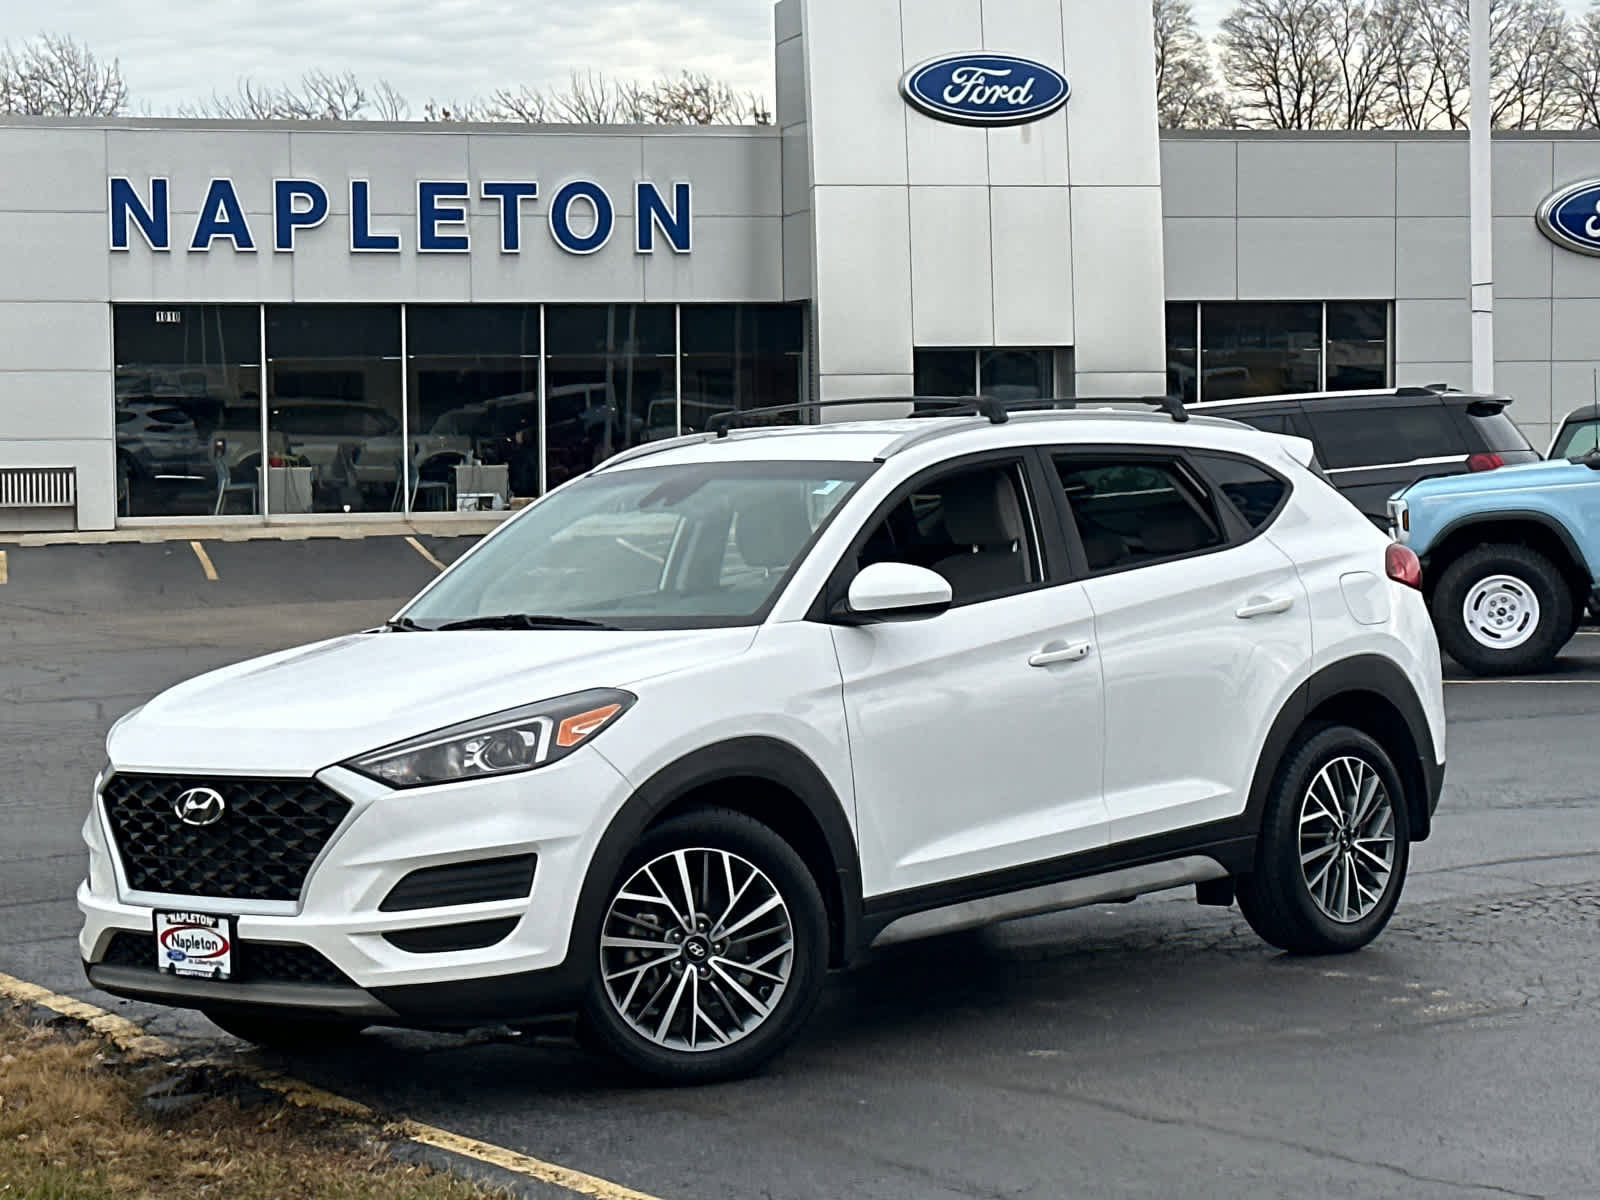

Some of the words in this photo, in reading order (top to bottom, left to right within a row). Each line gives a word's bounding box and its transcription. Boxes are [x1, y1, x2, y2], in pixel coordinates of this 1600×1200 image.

[943, 66, 1035, 104] Ford
[108, 177, 692, 254] NAPLETON
[171, 933, 218, 952] Napleton
